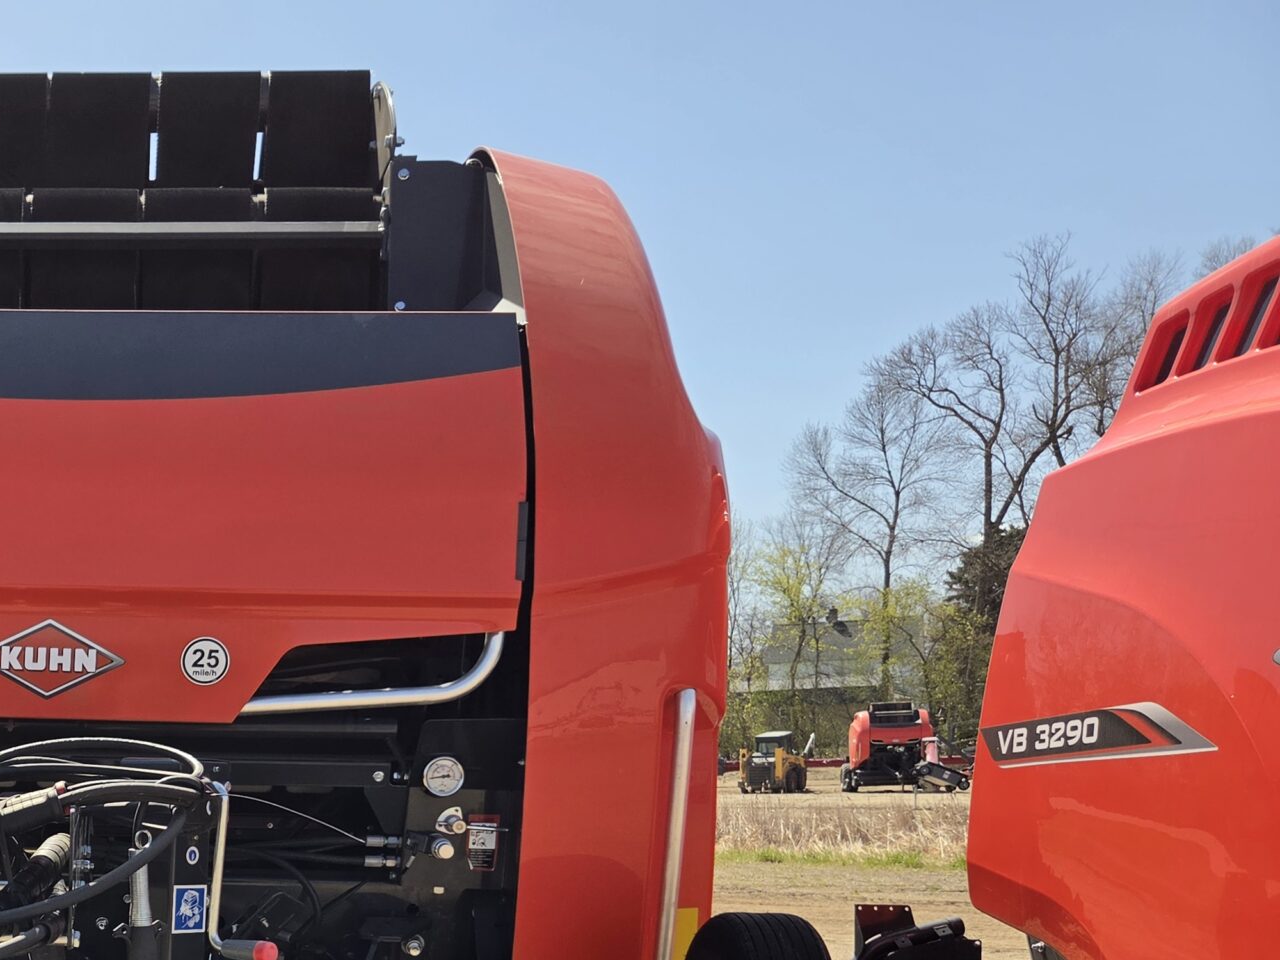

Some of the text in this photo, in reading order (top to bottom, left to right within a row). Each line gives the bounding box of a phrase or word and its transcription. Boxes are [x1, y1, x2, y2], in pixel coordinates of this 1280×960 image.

[0, 645, 97, 673] KUHN
[192, 648, 219, 668] 25
[192, 669, 217, 677] mile/h
[998, 716, 1099, 754] VB 3290
